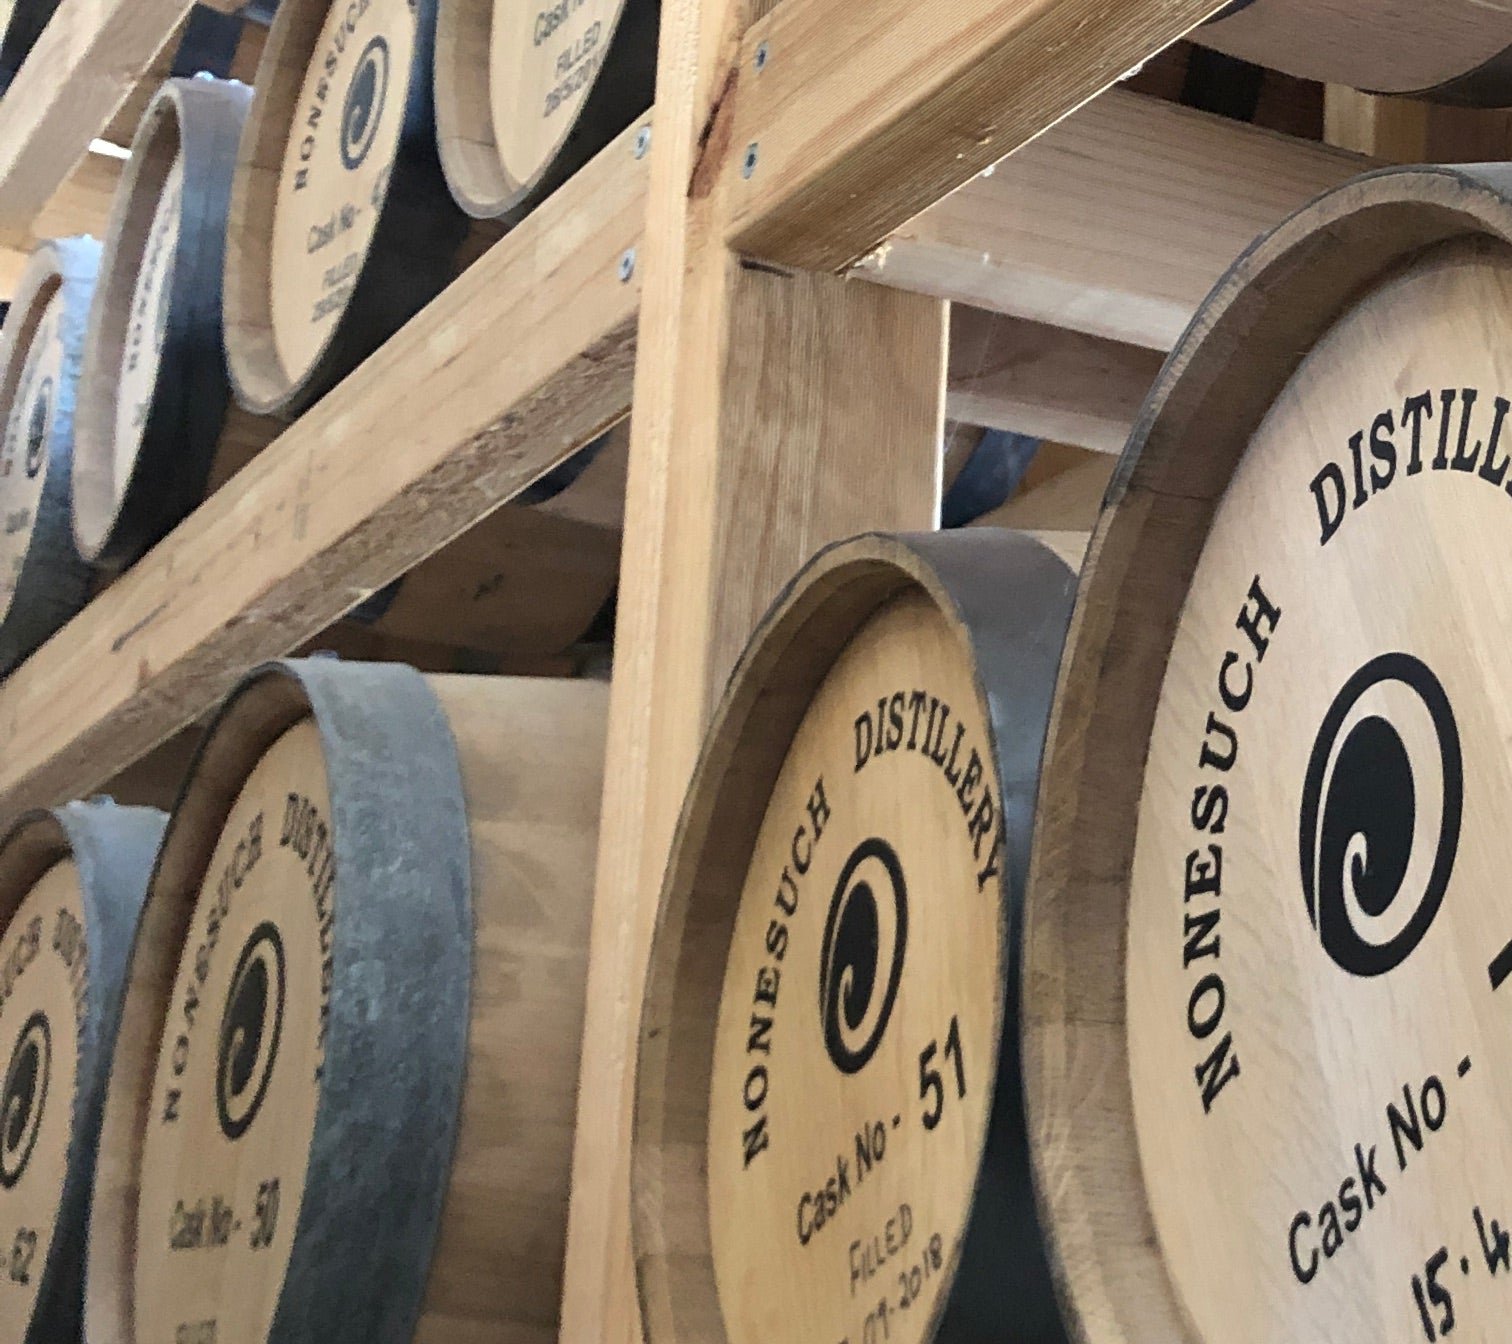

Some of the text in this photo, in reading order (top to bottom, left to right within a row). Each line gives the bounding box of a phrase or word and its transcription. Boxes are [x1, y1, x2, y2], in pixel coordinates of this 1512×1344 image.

[742, 690, 1007, 1169] NONESUCH DISTILLERY
[1183, 574, 1283, 1115] NONESUCH
[796, 1153, 852, 1247] Cask
[919, 1013, 966, 1131] 51
[1289, 1143, 1387, 1284] Cask
